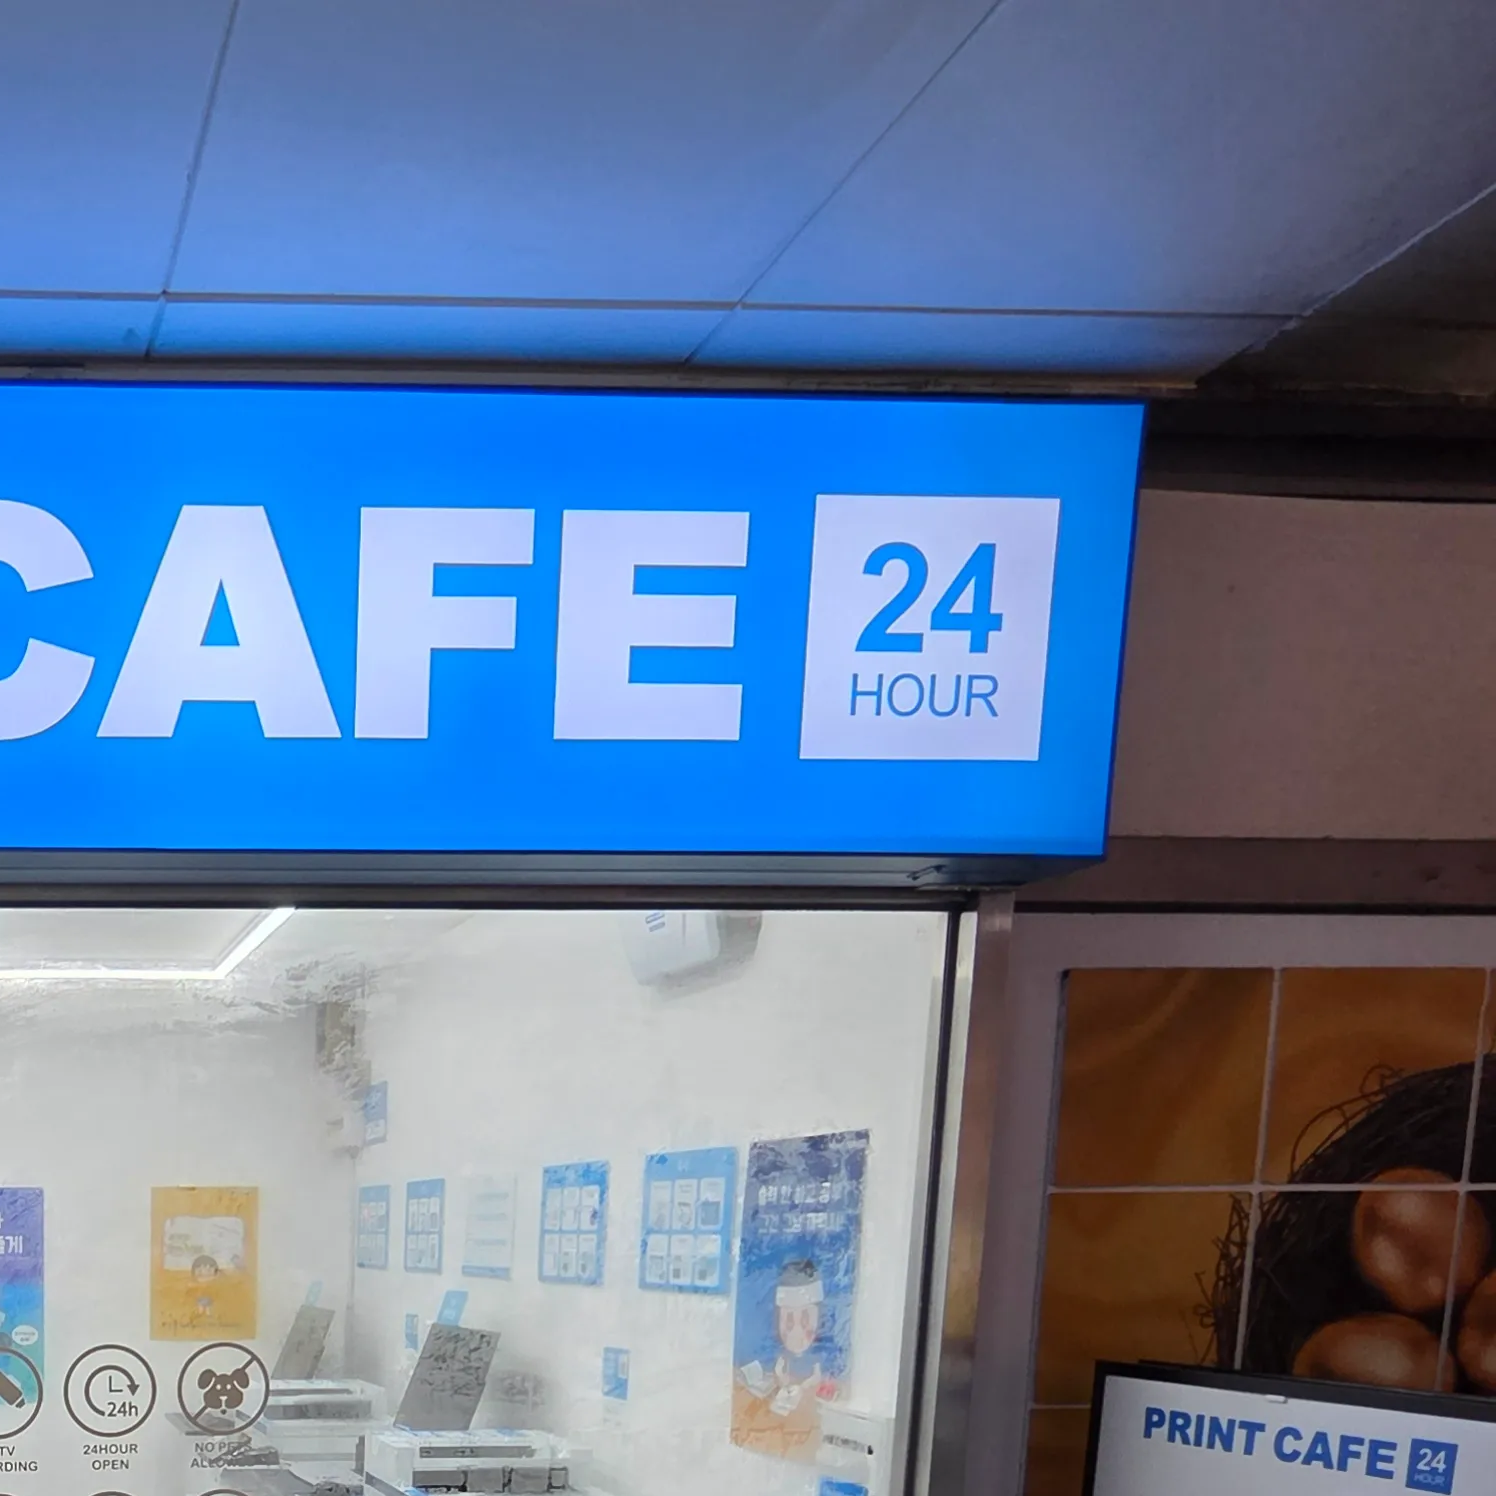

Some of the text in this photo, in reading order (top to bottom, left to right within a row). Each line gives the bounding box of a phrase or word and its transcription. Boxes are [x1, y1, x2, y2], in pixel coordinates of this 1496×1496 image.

[853, 541, 1003, 654] 24
[848, 671, 1000, 720] HOUR
[107, 1402, 138, 1418] 24h
[83, 1443, 138, 1455] 24HOUR
[195, 1442, 215, 1453] NO
[1143, 1407, 1447, 1480] PRINT CAFE 24
[91, 1460, 130, 1471] OPEN
[190, 1457, 253, 1469] ALLO
